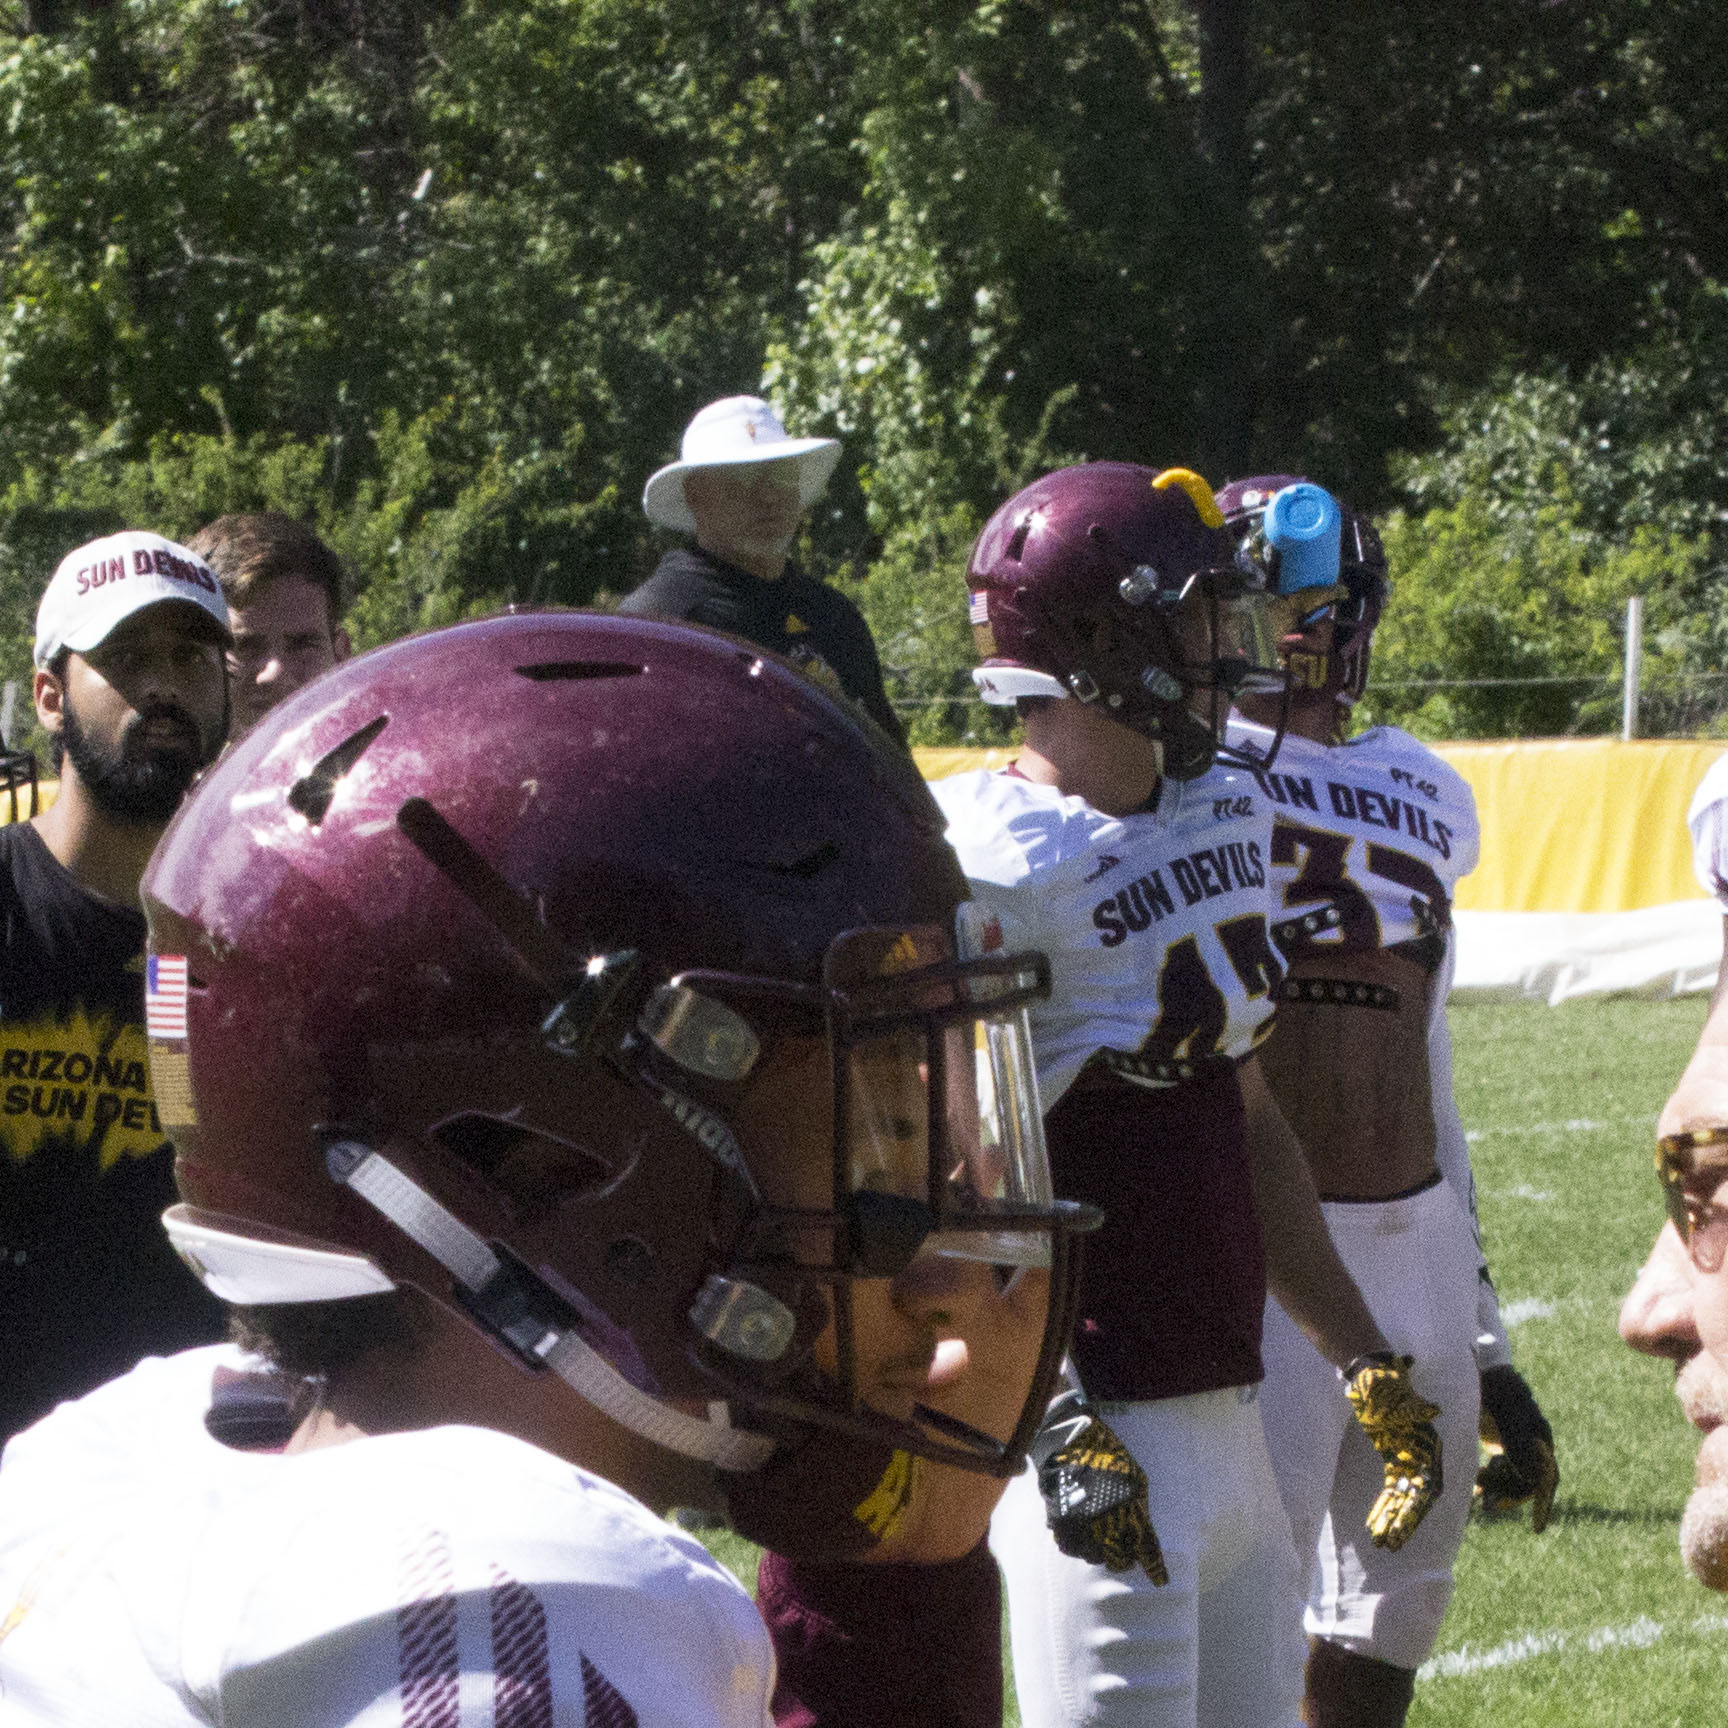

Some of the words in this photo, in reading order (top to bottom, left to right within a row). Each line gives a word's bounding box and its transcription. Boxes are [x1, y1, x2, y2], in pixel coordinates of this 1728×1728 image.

[77, 554, 126, 596] SUN
[1327, 780, 1453, 861] DEVILS
[1093, 869, 1175, 948] SUN
[1169, 841, 1266, 907] DEVILS
[3, 1083, 88, 1121] SUN
